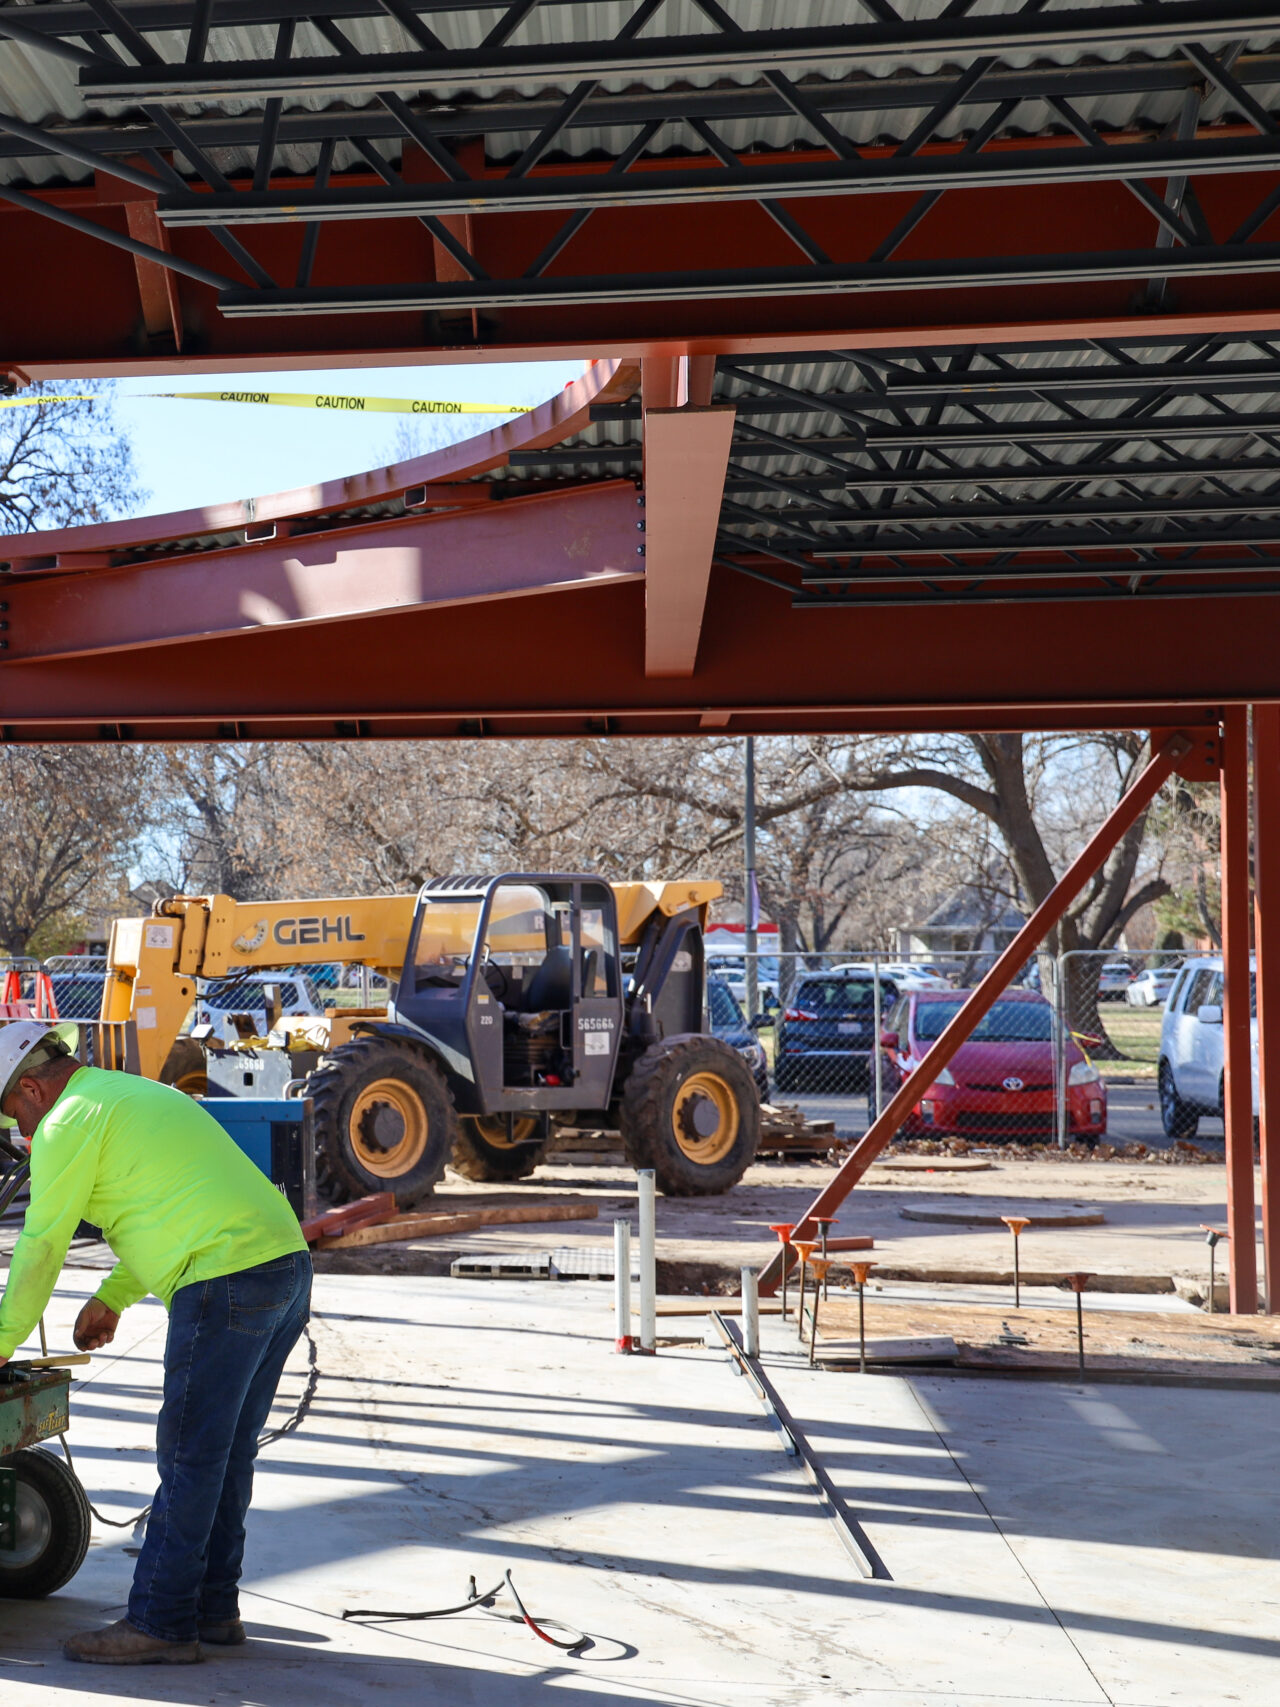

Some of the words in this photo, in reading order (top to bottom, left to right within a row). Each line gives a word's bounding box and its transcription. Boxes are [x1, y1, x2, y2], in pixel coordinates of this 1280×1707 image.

[220, 390, 269, 404] CAUTION
[315, 395, 365, 409] CAUTION
[412, 401, 462, 414] CAUTION
[273, 915, 366, 945] GEHL
[480, 1015, 493, 1025] 220
